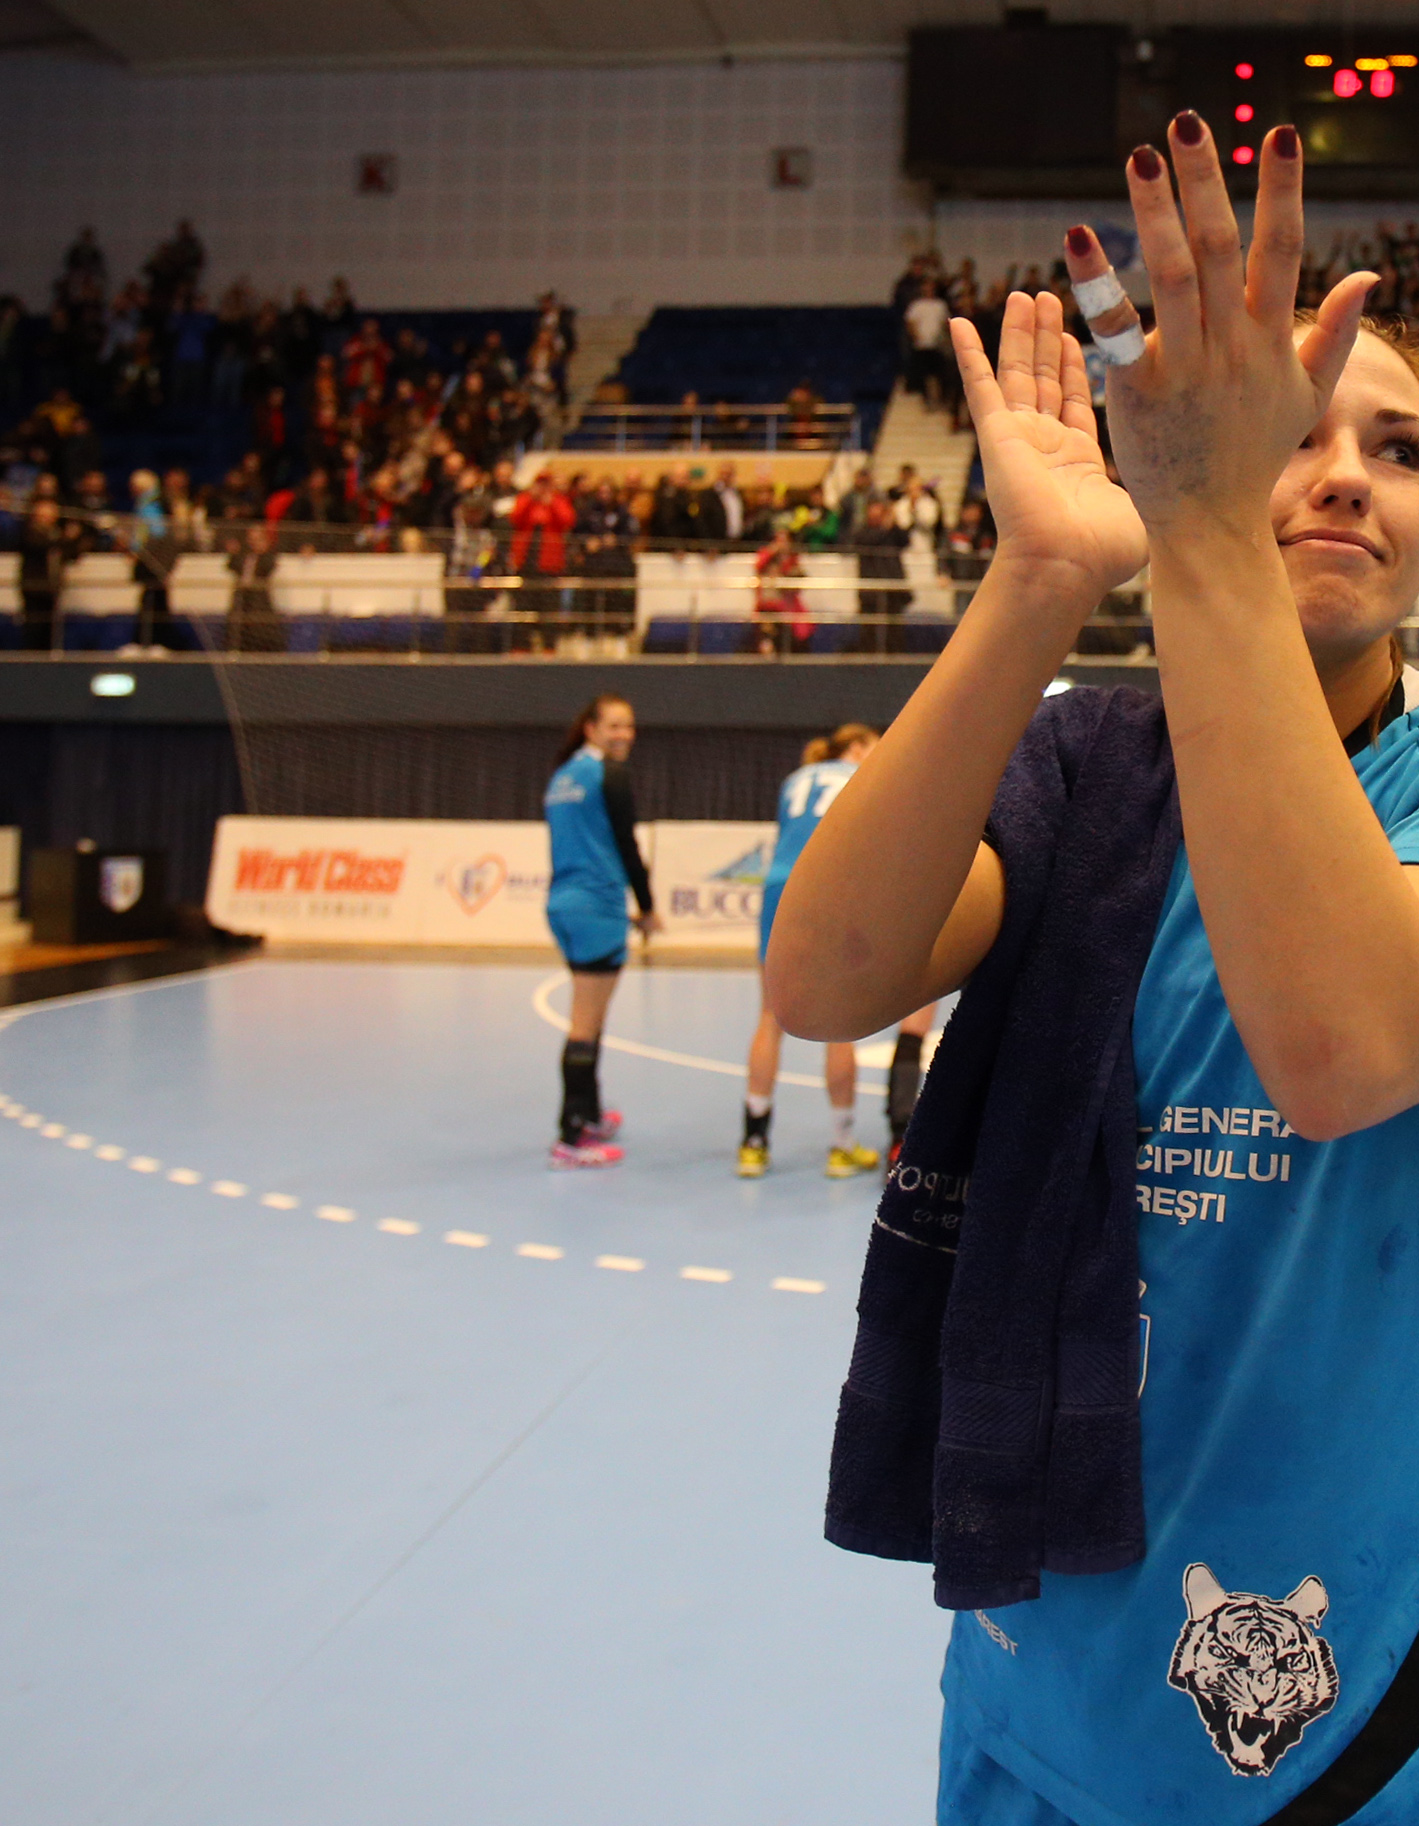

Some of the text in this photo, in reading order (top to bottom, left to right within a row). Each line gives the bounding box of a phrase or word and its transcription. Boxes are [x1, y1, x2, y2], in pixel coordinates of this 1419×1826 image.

[784, 771, 850, 818] 17
[235, 849, 406, 895] World Class
[1136, 1143, 1291, 1182] CIPIULUI
